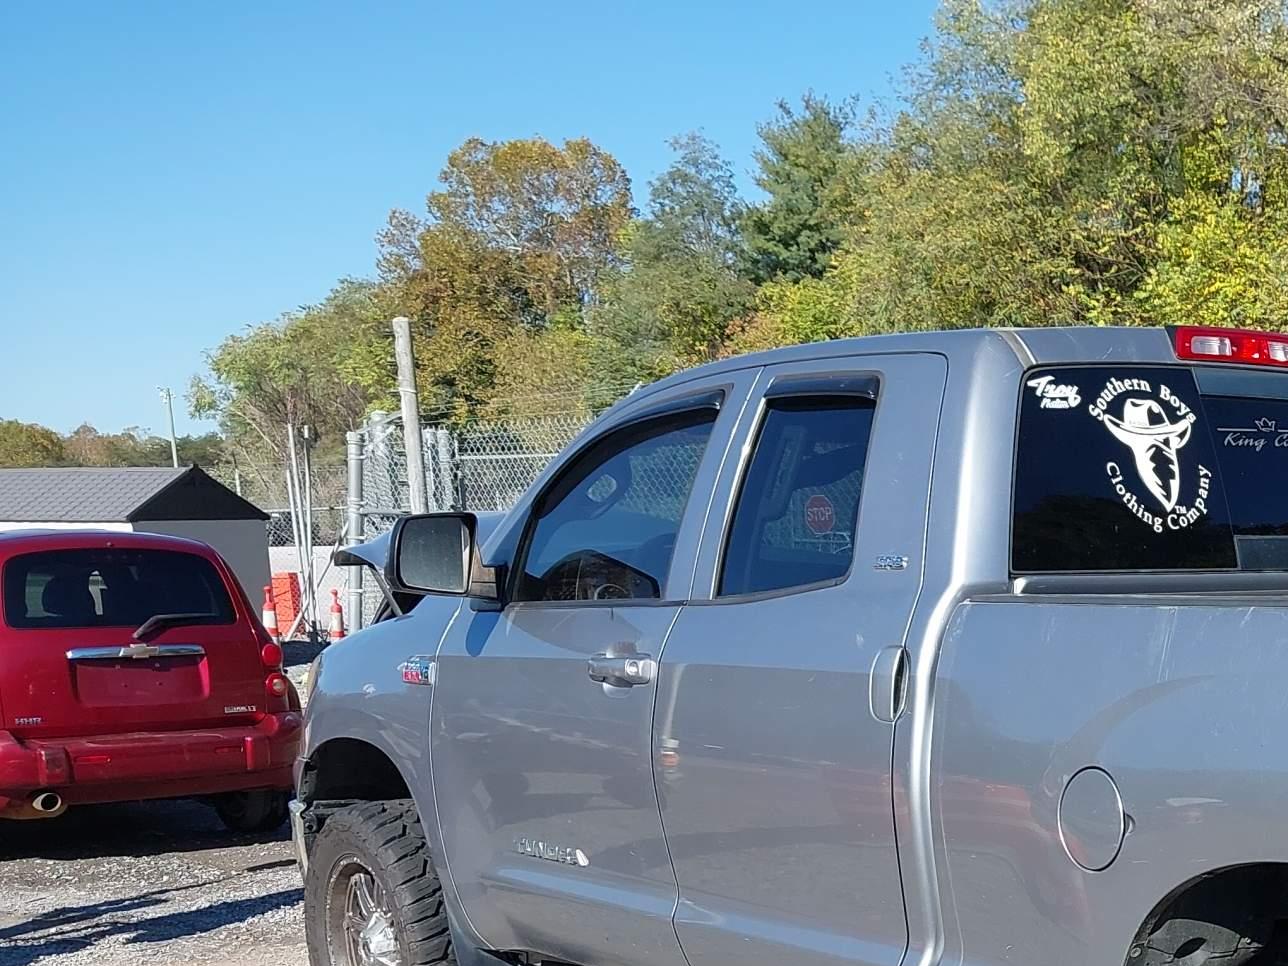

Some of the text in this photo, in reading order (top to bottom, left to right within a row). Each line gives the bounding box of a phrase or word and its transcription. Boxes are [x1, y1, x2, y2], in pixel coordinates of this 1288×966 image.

[1026, 375, 1082, 408] Troy
[1088, 377, 1197, 423] Southern Boys
[1223, 432, 1267, 452] King
[807, 506, 832, 521] STOP
[1106, 461, 1212, 533] Clothing Company
